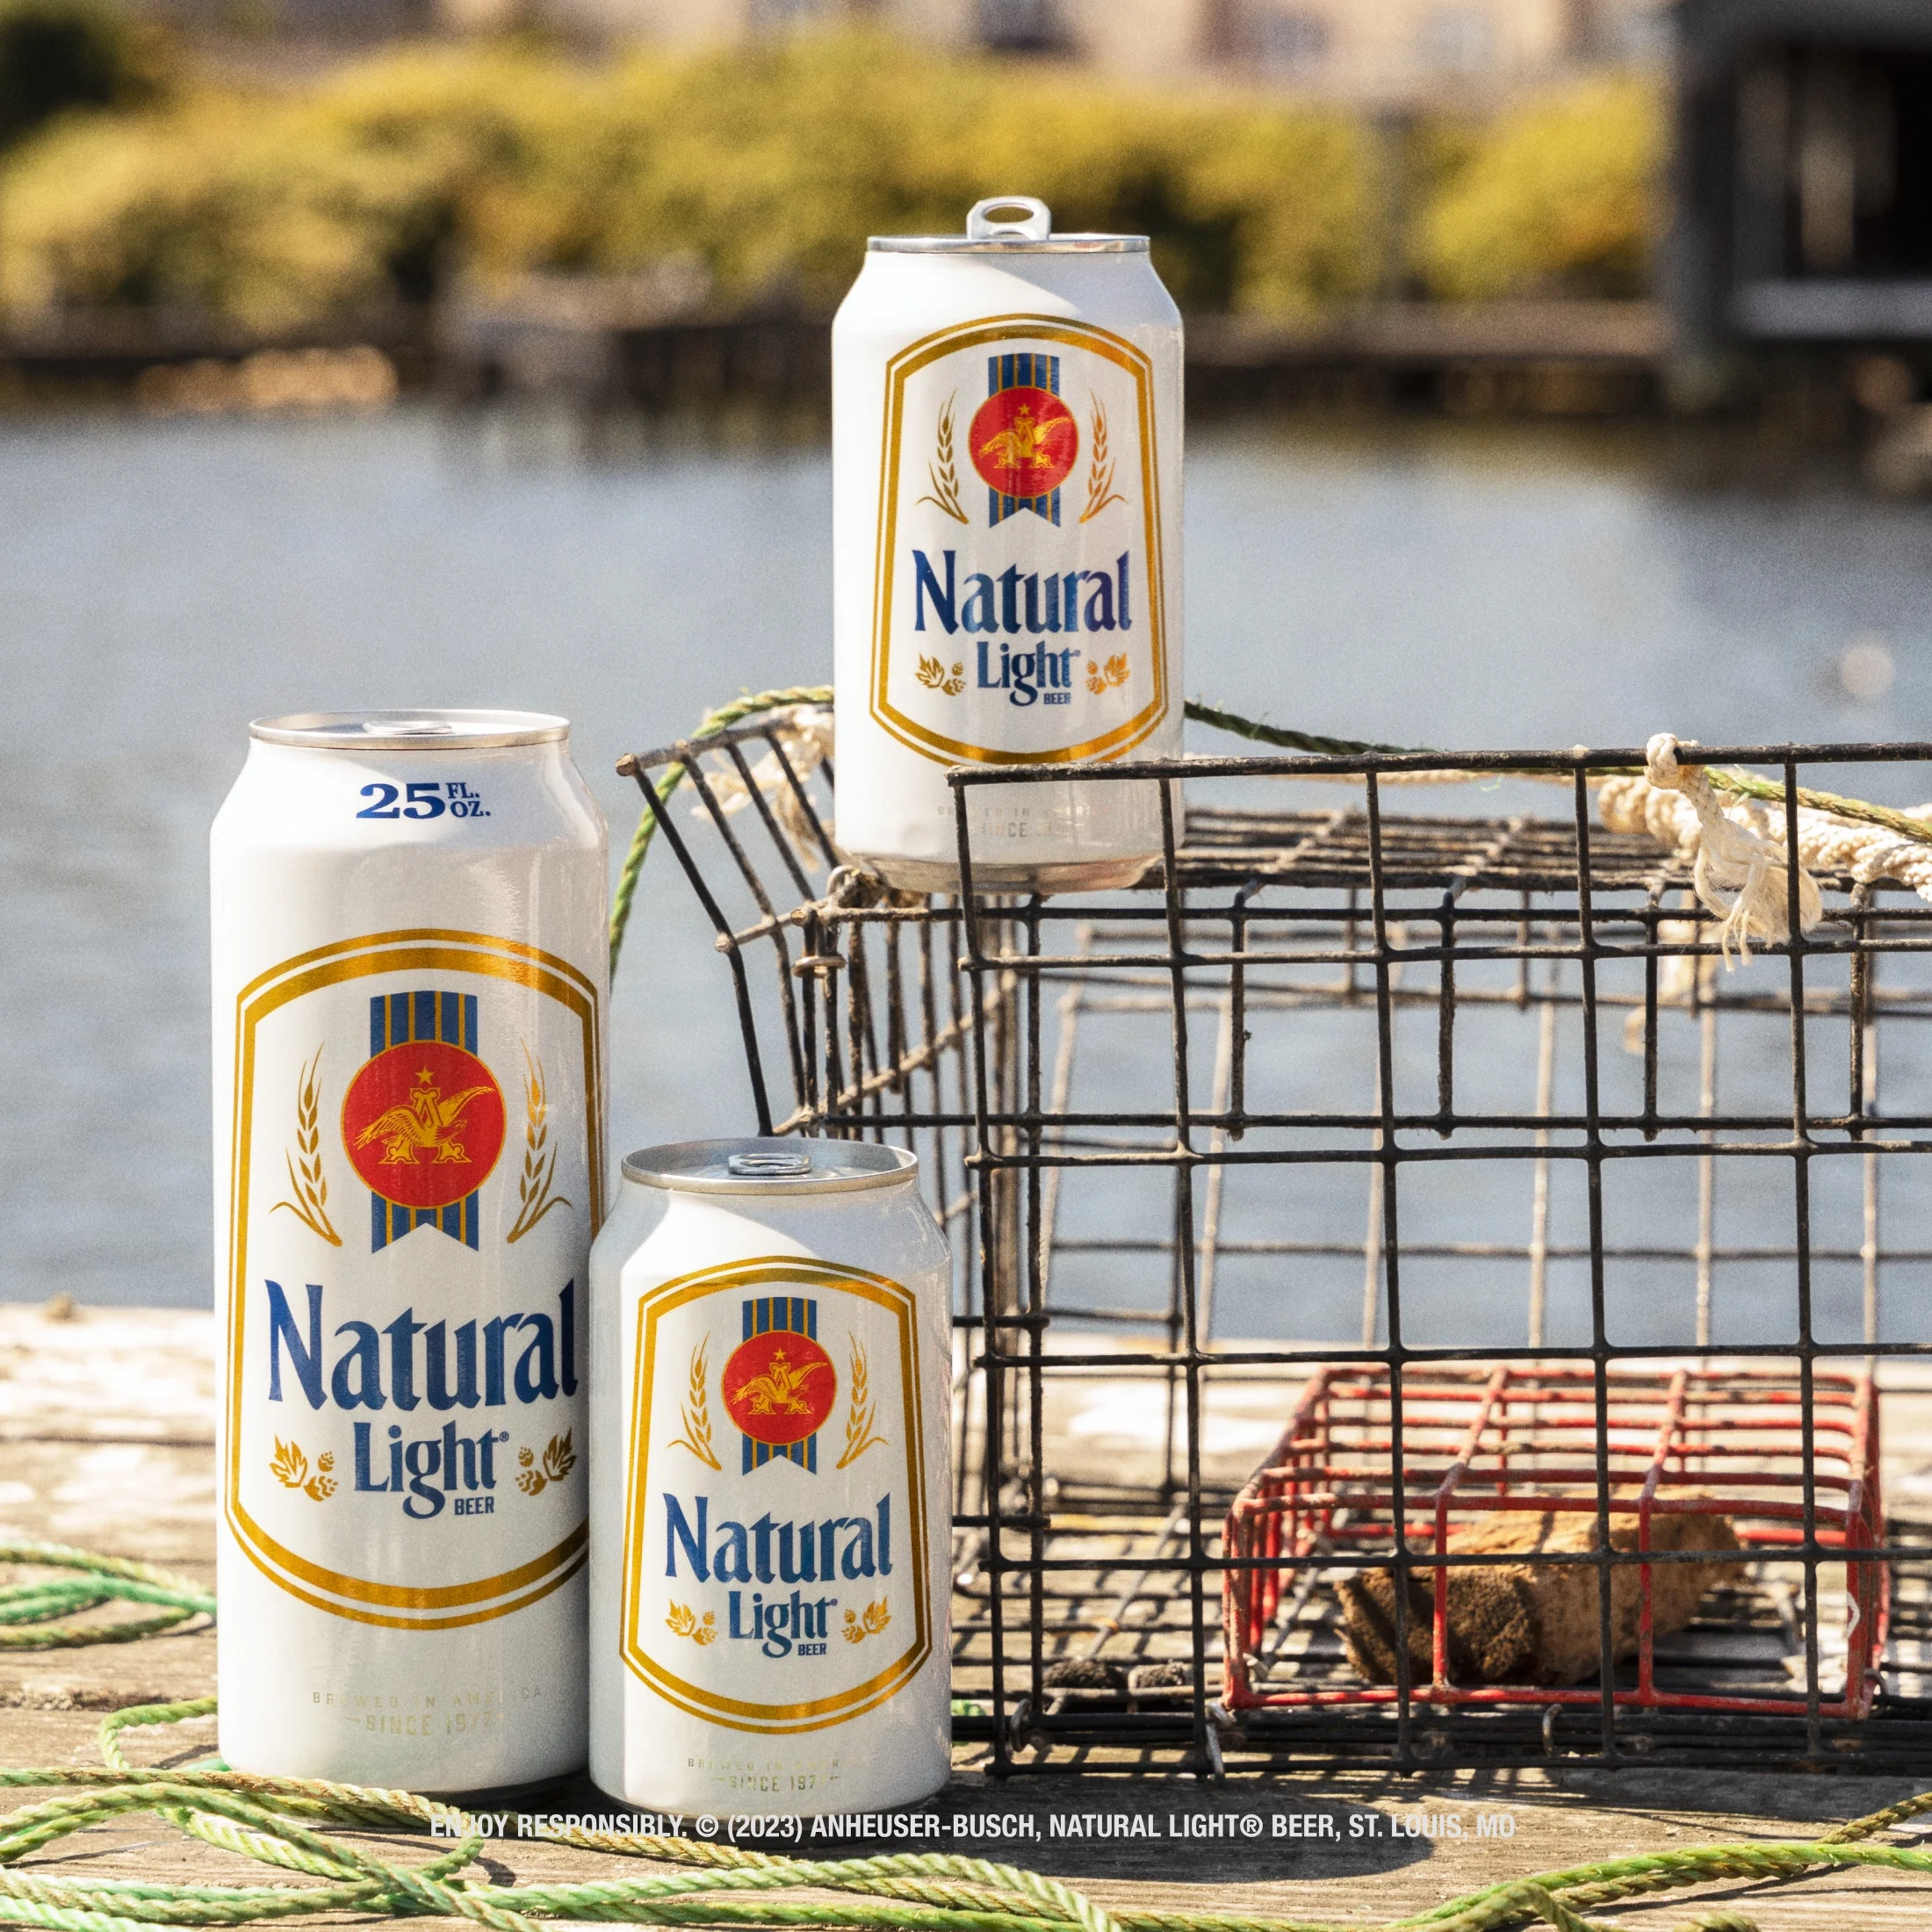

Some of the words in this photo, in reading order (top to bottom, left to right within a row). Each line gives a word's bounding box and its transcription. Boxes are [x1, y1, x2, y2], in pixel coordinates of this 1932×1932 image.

[912, 550, 1132, 635] Natural
[1043, 693, 1071, 705] BEER
[445, 782, 480, 798] FL.
[356, 783, 445, 819] 25
[450, 801, 491, 818] OZ.
[264, 1277, 578, 1411] Natural
[454, 1496, 494, 1516] BEER
[662, 1492, 893, 1584] Natural
[797, 1643, 827, 1656] BEER
[365, 1714, 433, 1736] SINCE
[728, 1775, 781, 1792] SINCE
